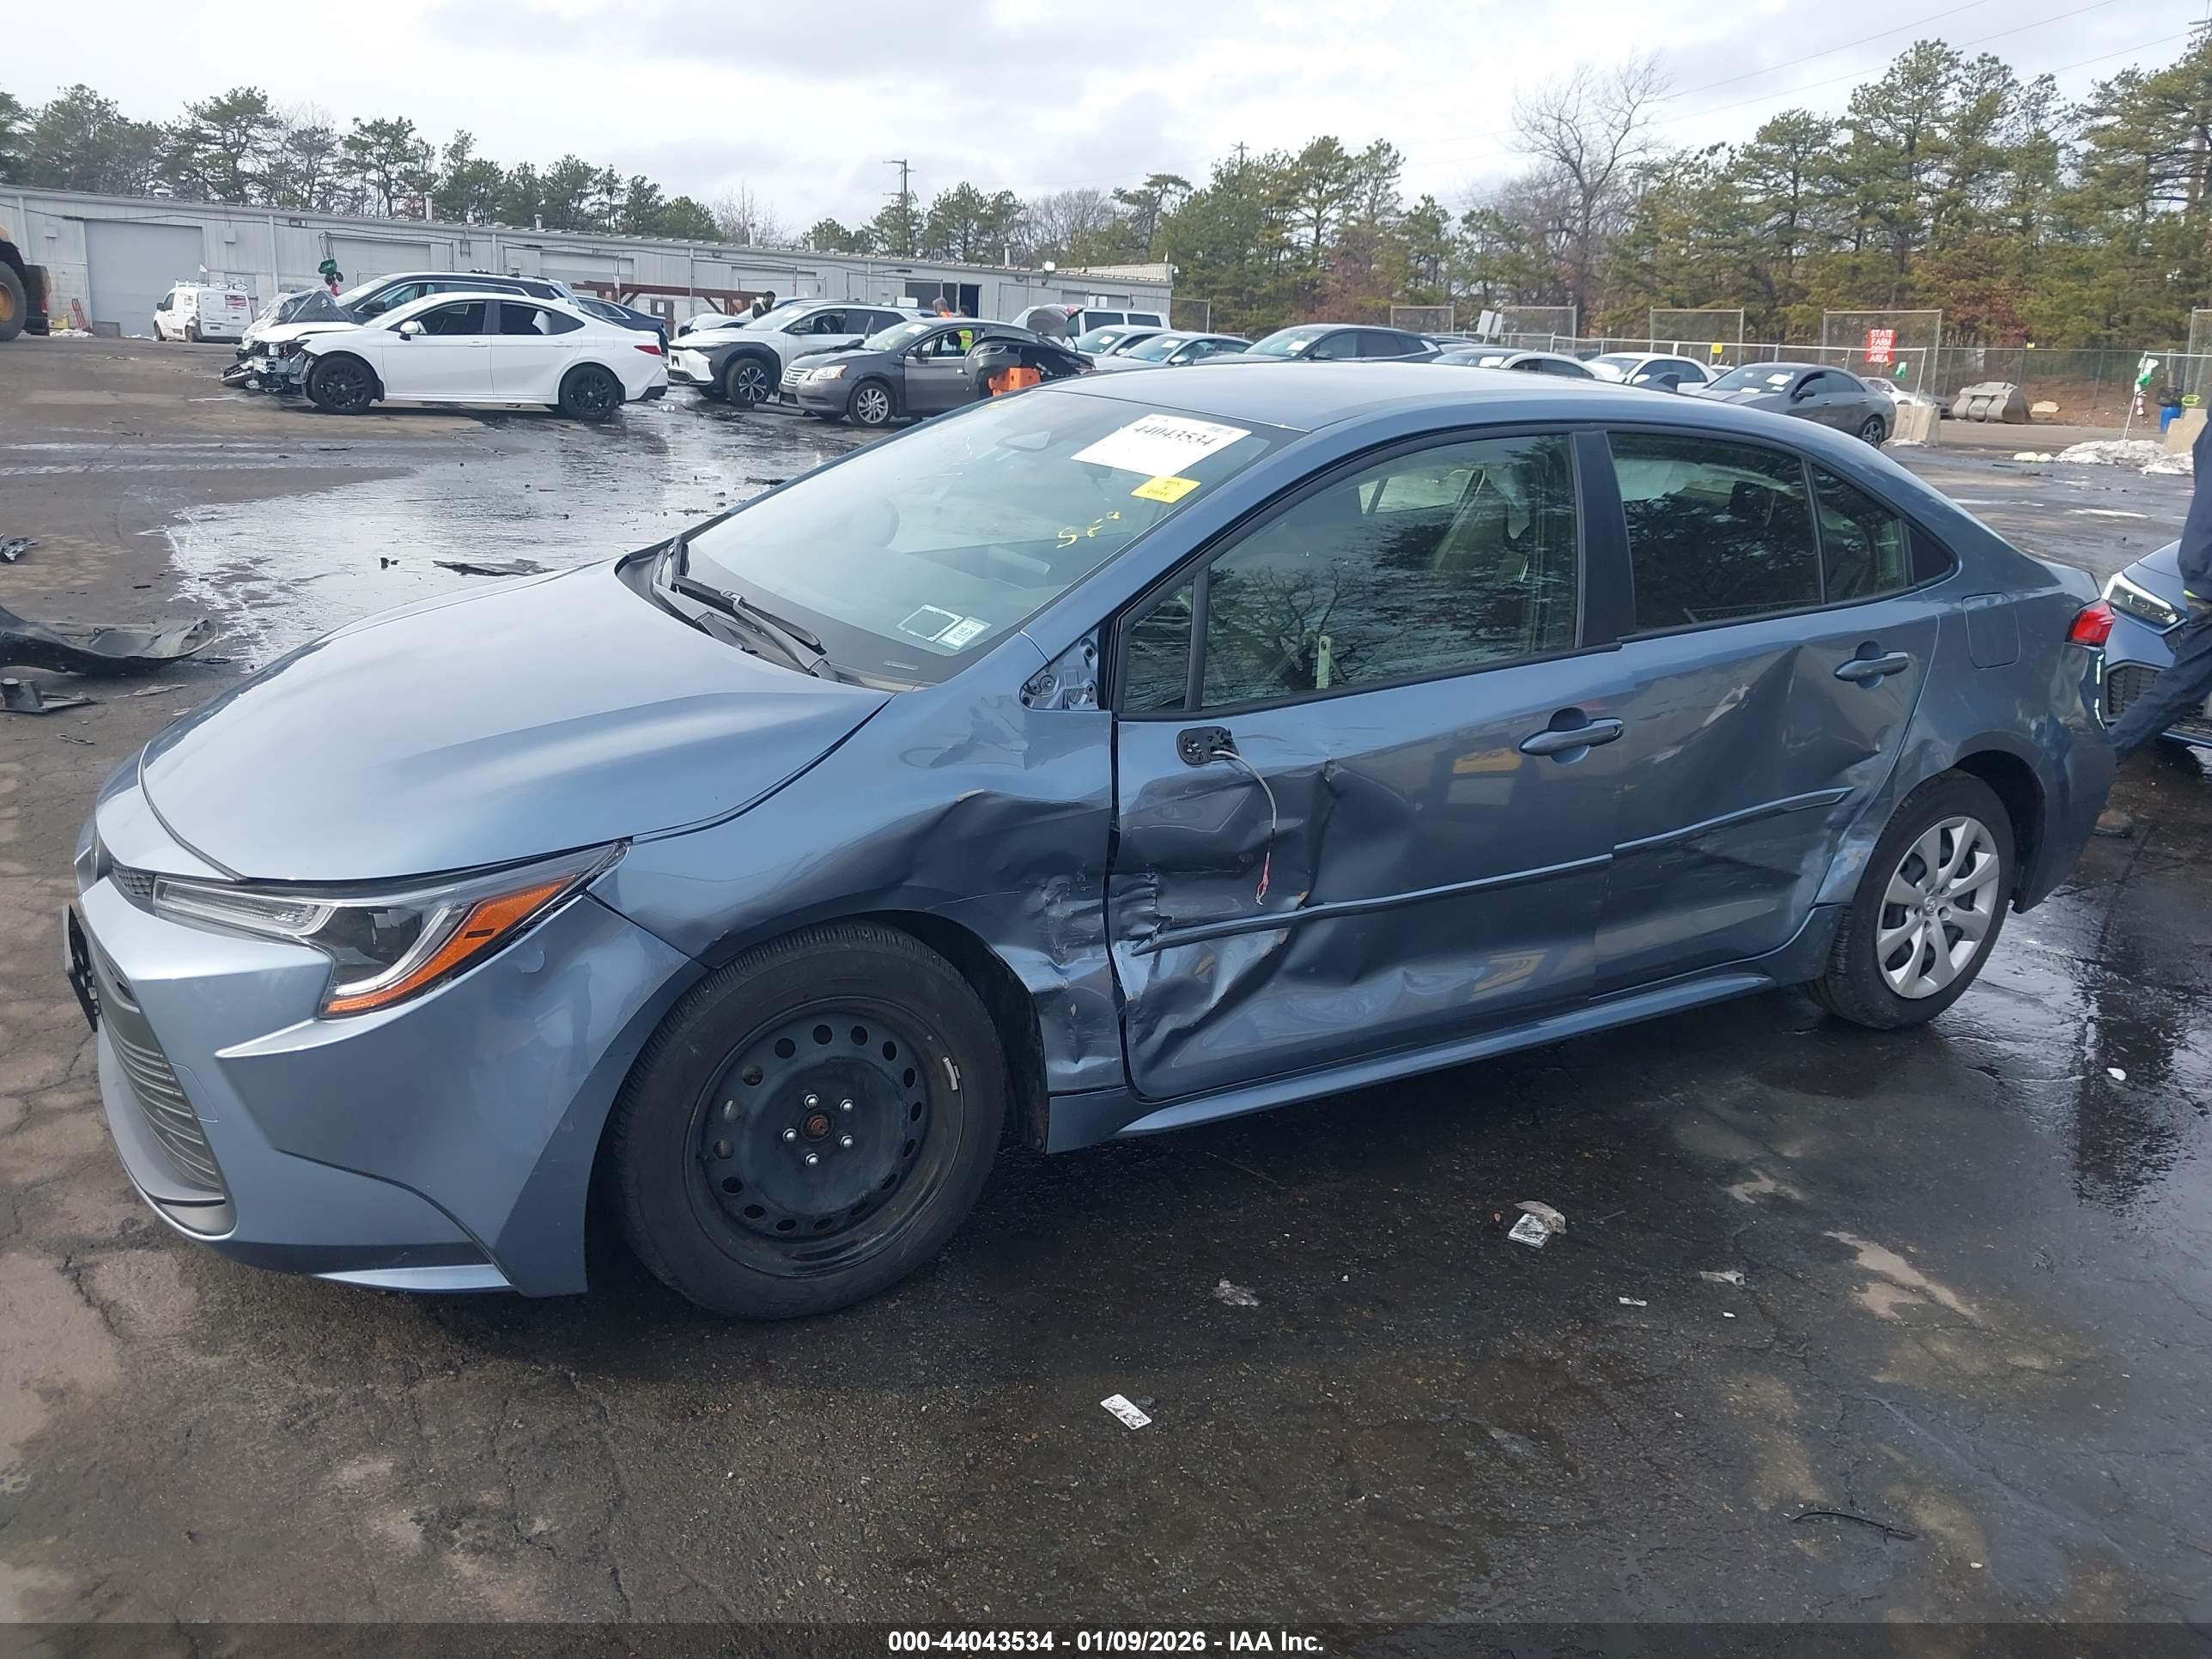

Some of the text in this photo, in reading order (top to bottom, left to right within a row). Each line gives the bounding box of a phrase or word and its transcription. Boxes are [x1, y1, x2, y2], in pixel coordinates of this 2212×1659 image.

[1870, 329, 1893, 337] STATE
[1870, 337, 1892, 346] FARM
[1869, 354, 1889, 362] AREA
[1133, 424, 1218, 447] 44043534
